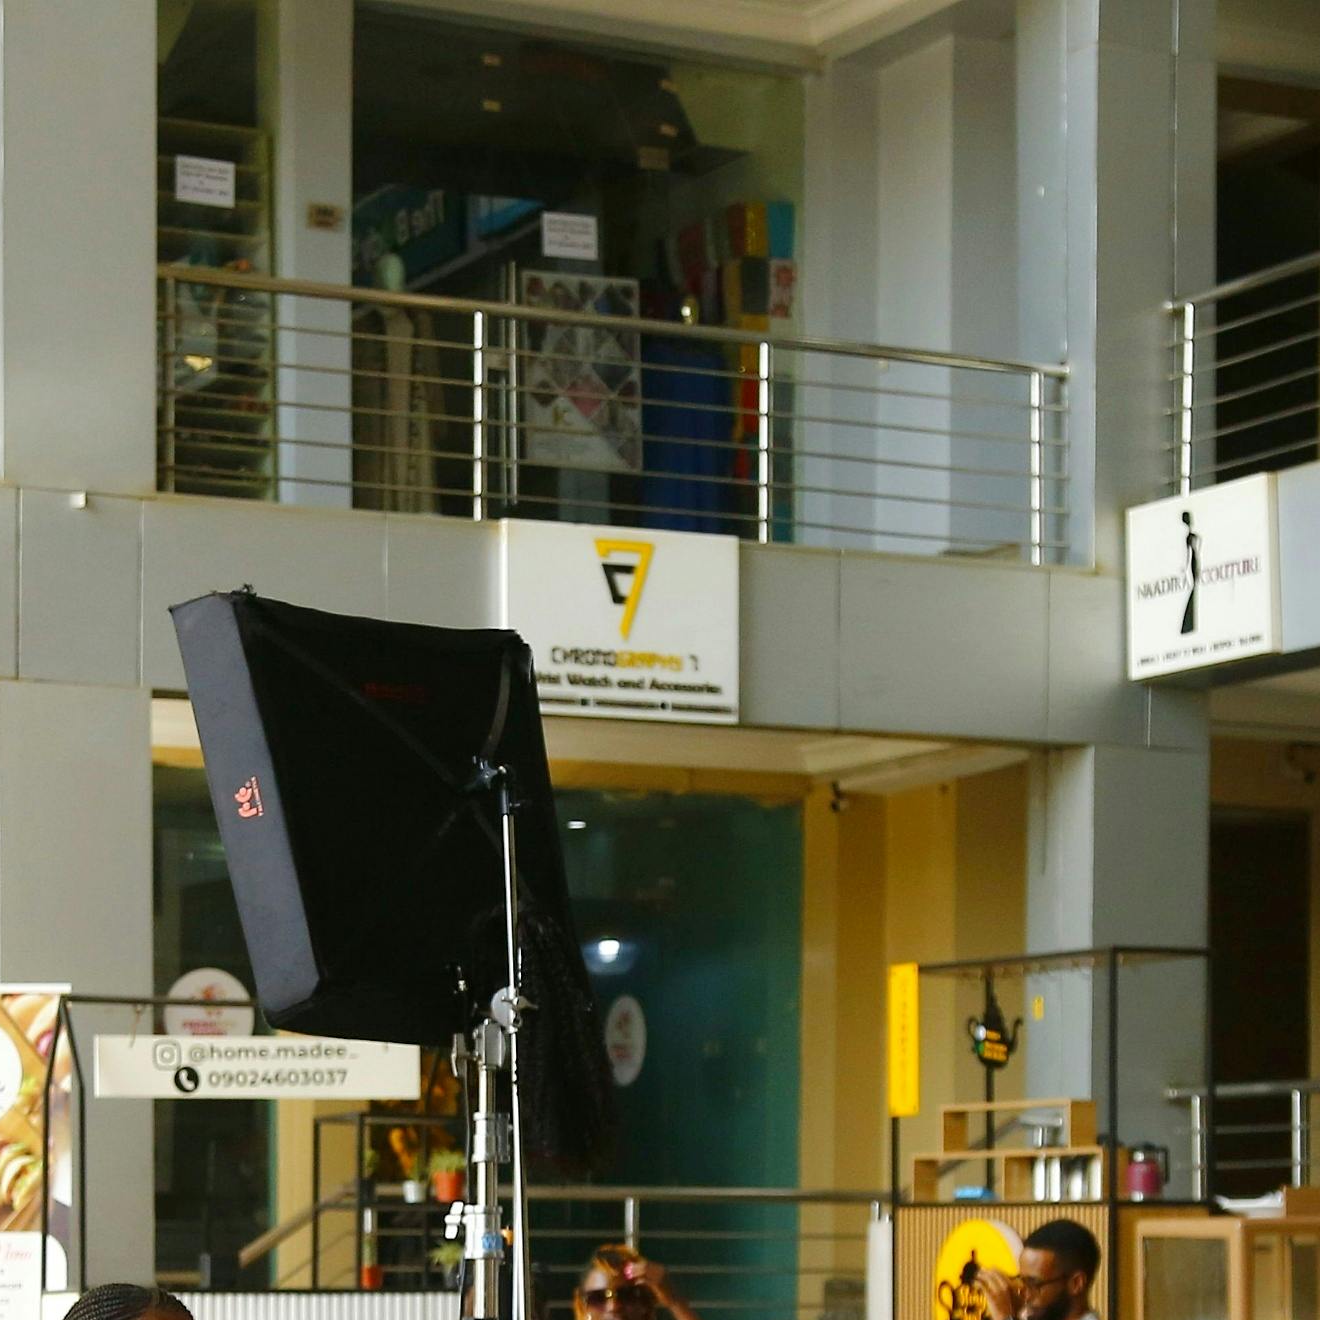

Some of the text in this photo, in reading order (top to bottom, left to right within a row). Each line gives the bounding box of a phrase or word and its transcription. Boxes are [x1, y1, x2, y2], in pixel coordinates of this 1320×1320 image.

[567, 673, 613, 689] Watch
[617, 677, 646, 690] and
[649, 678, 723, 695] Accessories
[208, 1068, 347, 1087] 09024603037
